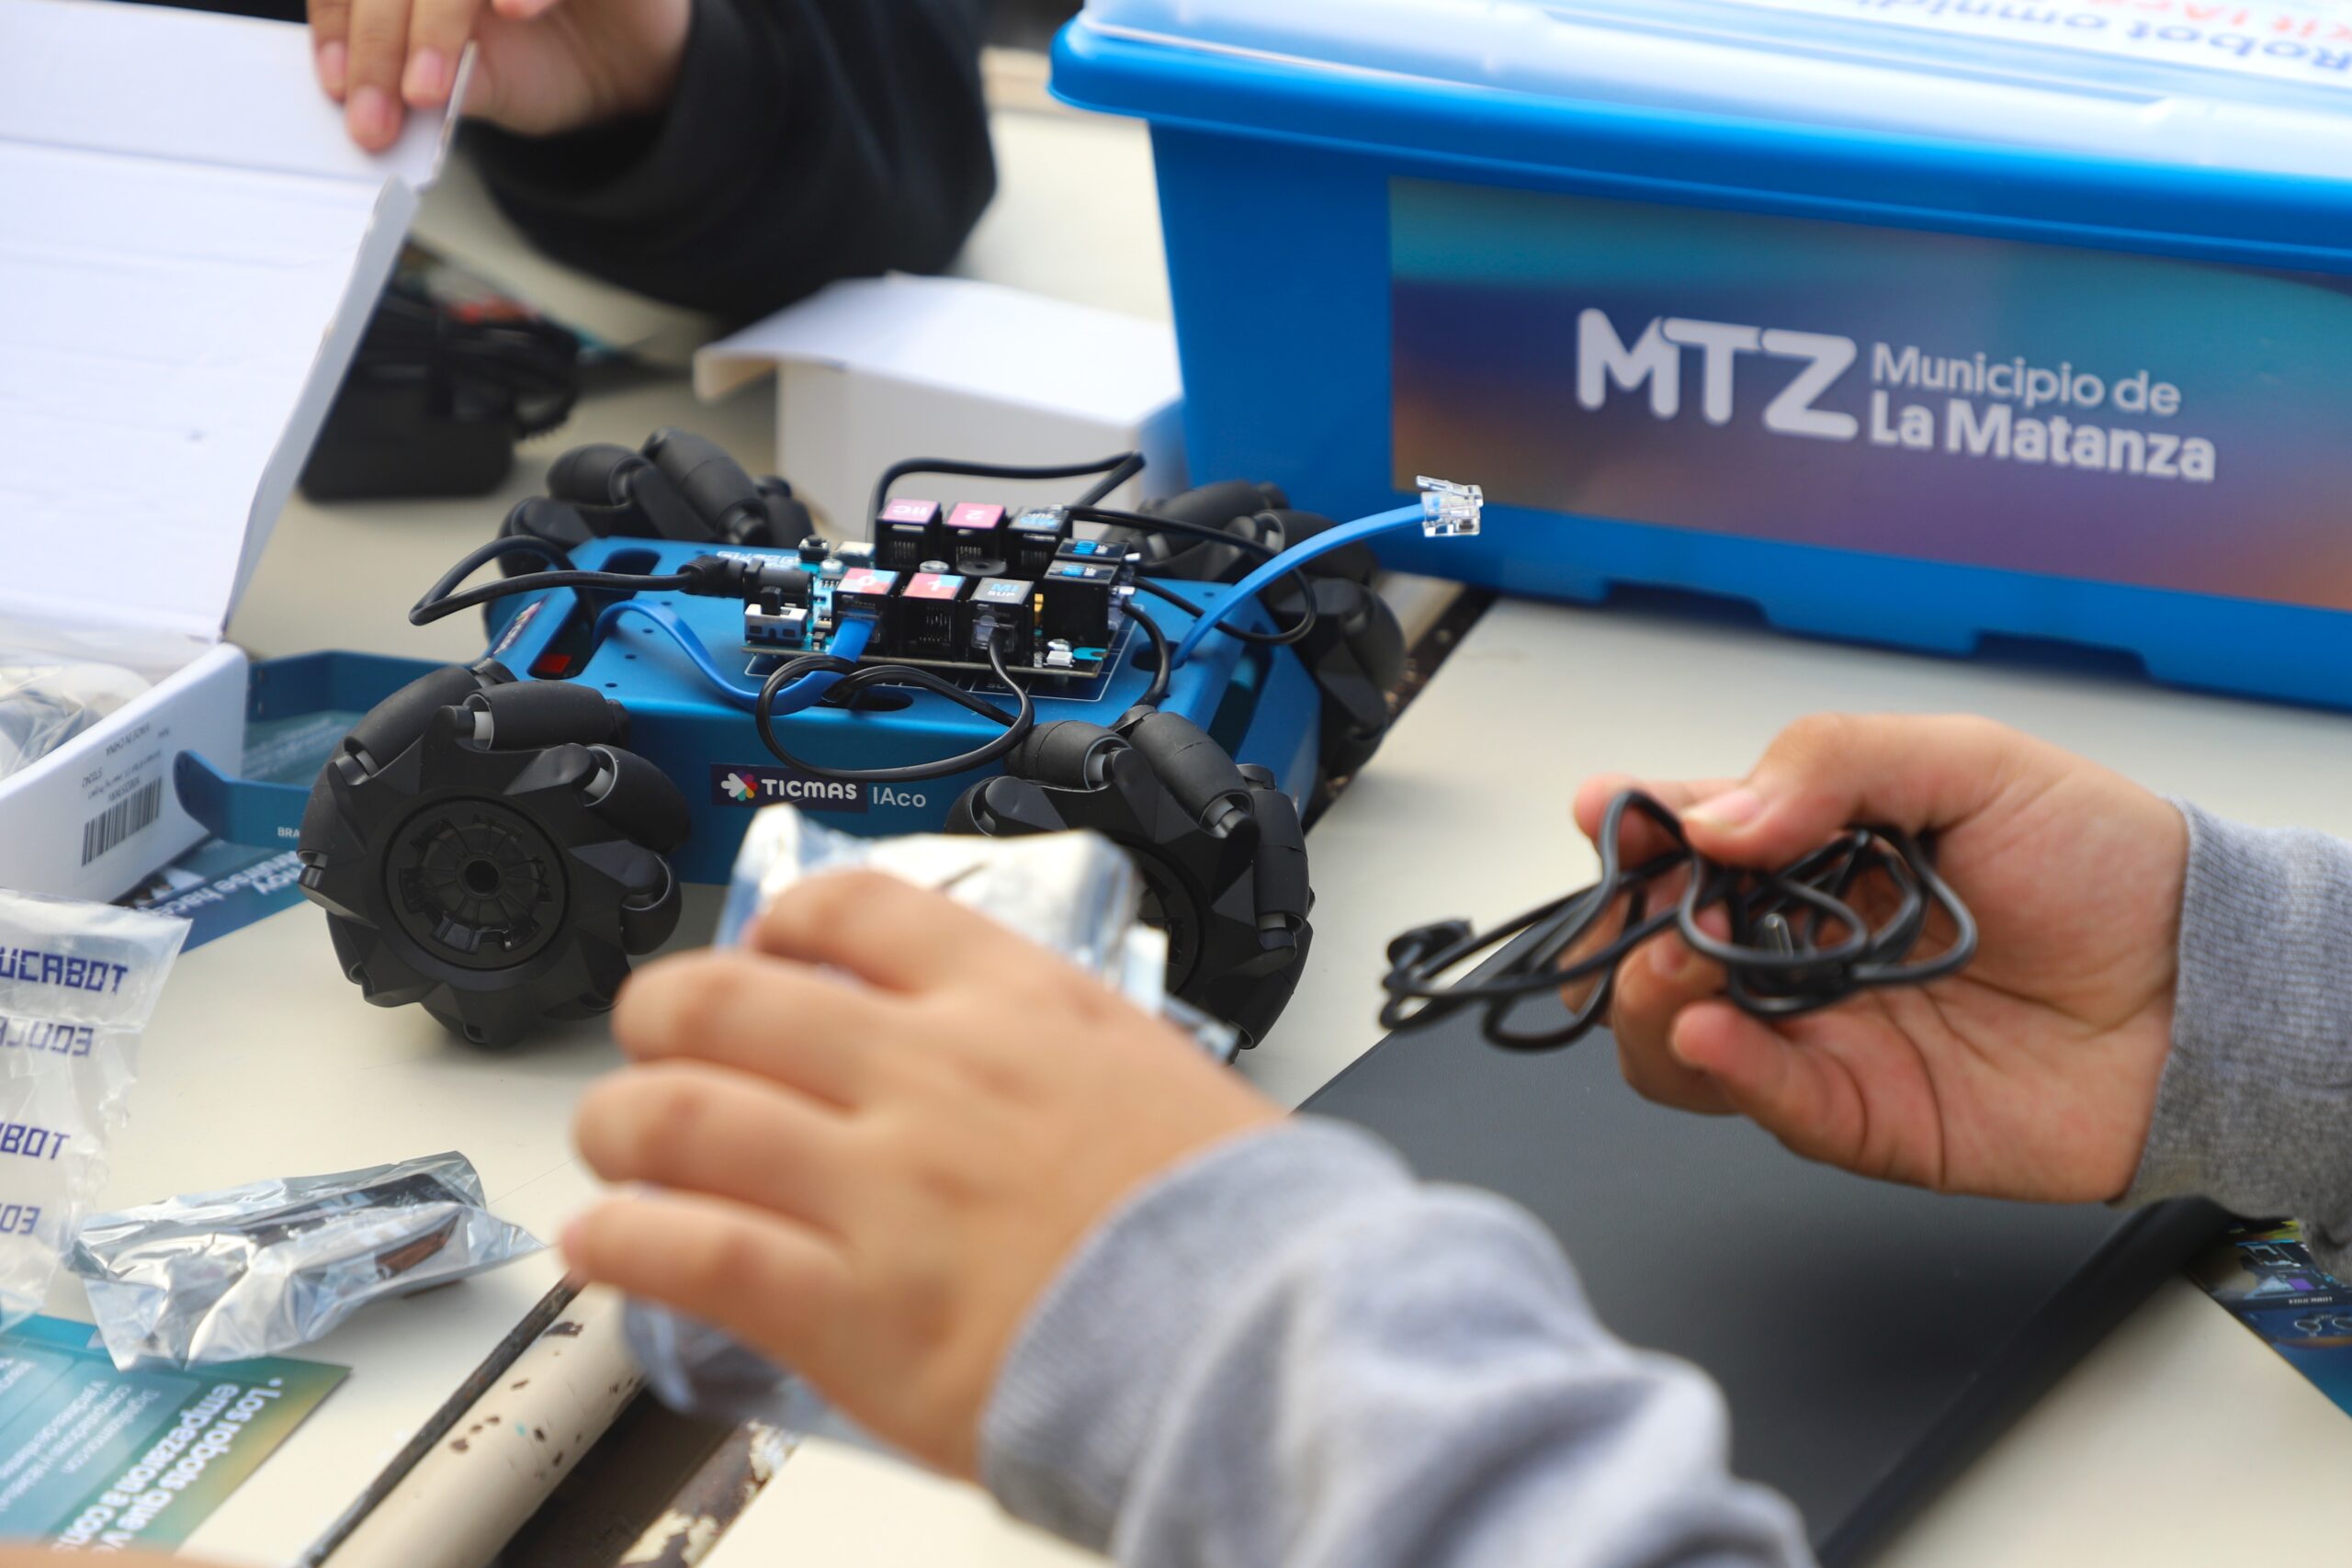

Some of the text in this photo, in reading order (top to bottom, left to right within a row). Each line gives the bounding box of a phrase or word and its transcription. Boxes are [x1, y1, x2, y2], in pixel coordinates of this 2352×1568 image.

[2126, 22, 2352, 71] Robot
[1577, 308, 1859, 441] MTZ
[1872, 342, 2181, 416] Municipio de
[1871, 389, 2216, 482] La Matanza
[965, 509, 986, 520] 2
[927, 580, 943, 592] 1
[987, 590, 1016, 598] SUP
[989, 582, 1020, 592] MI
[761, 778, 926, 808] TICMAS IAco
[0, 1122, 70, 1161] BOT
[225, 1387, 281, 1422] Los
[113, 1383, 239, 1495] empezaron
[158, 1420, 241, 1491] robots
[97, 1489, 130, 1507] a
[116, 1488, 173, 1531] que
